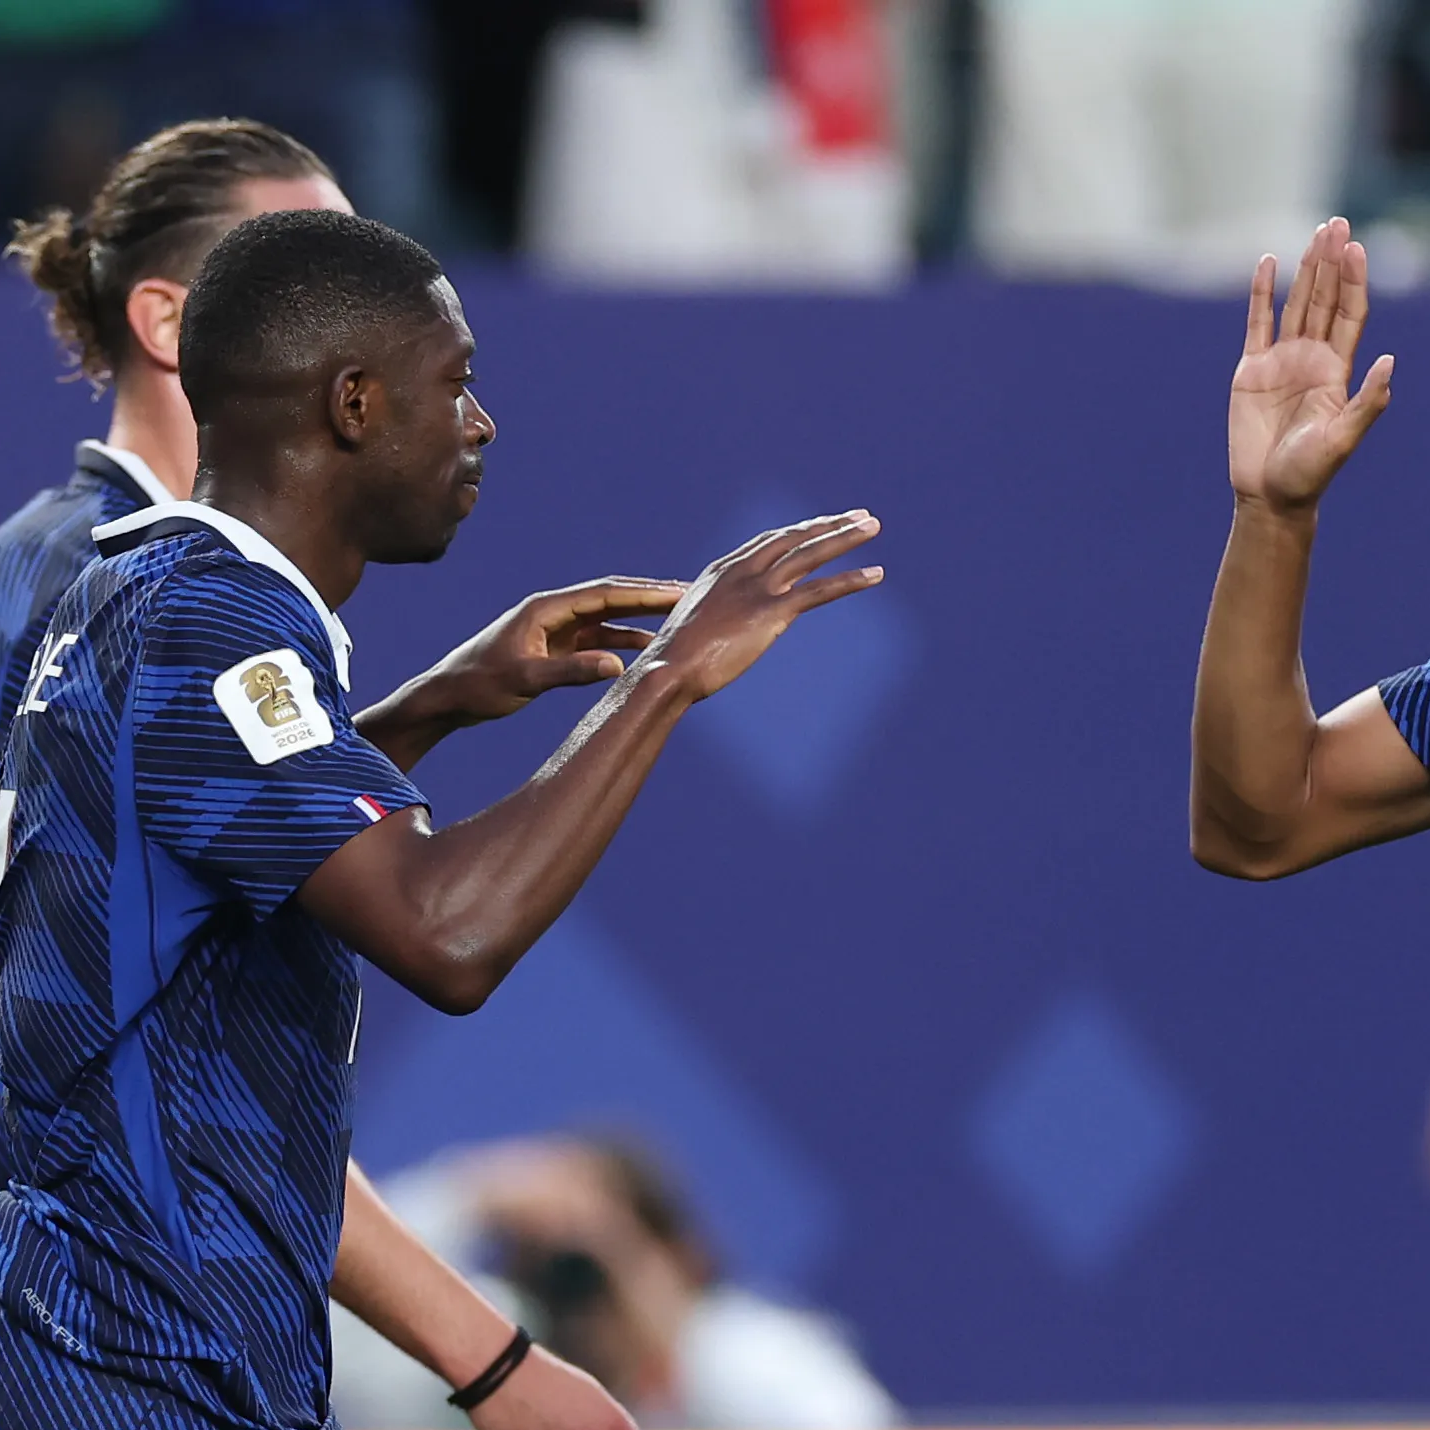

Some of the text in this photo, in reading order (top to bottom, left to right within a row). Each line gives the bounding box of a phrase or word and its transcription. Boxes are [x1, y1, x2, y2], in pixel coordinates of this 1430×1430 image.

[274, 707, 298, 721] FIFA
[275, 728, 316, 748] 2026
[22, 1287, 86, 1351] AERO-FIT
